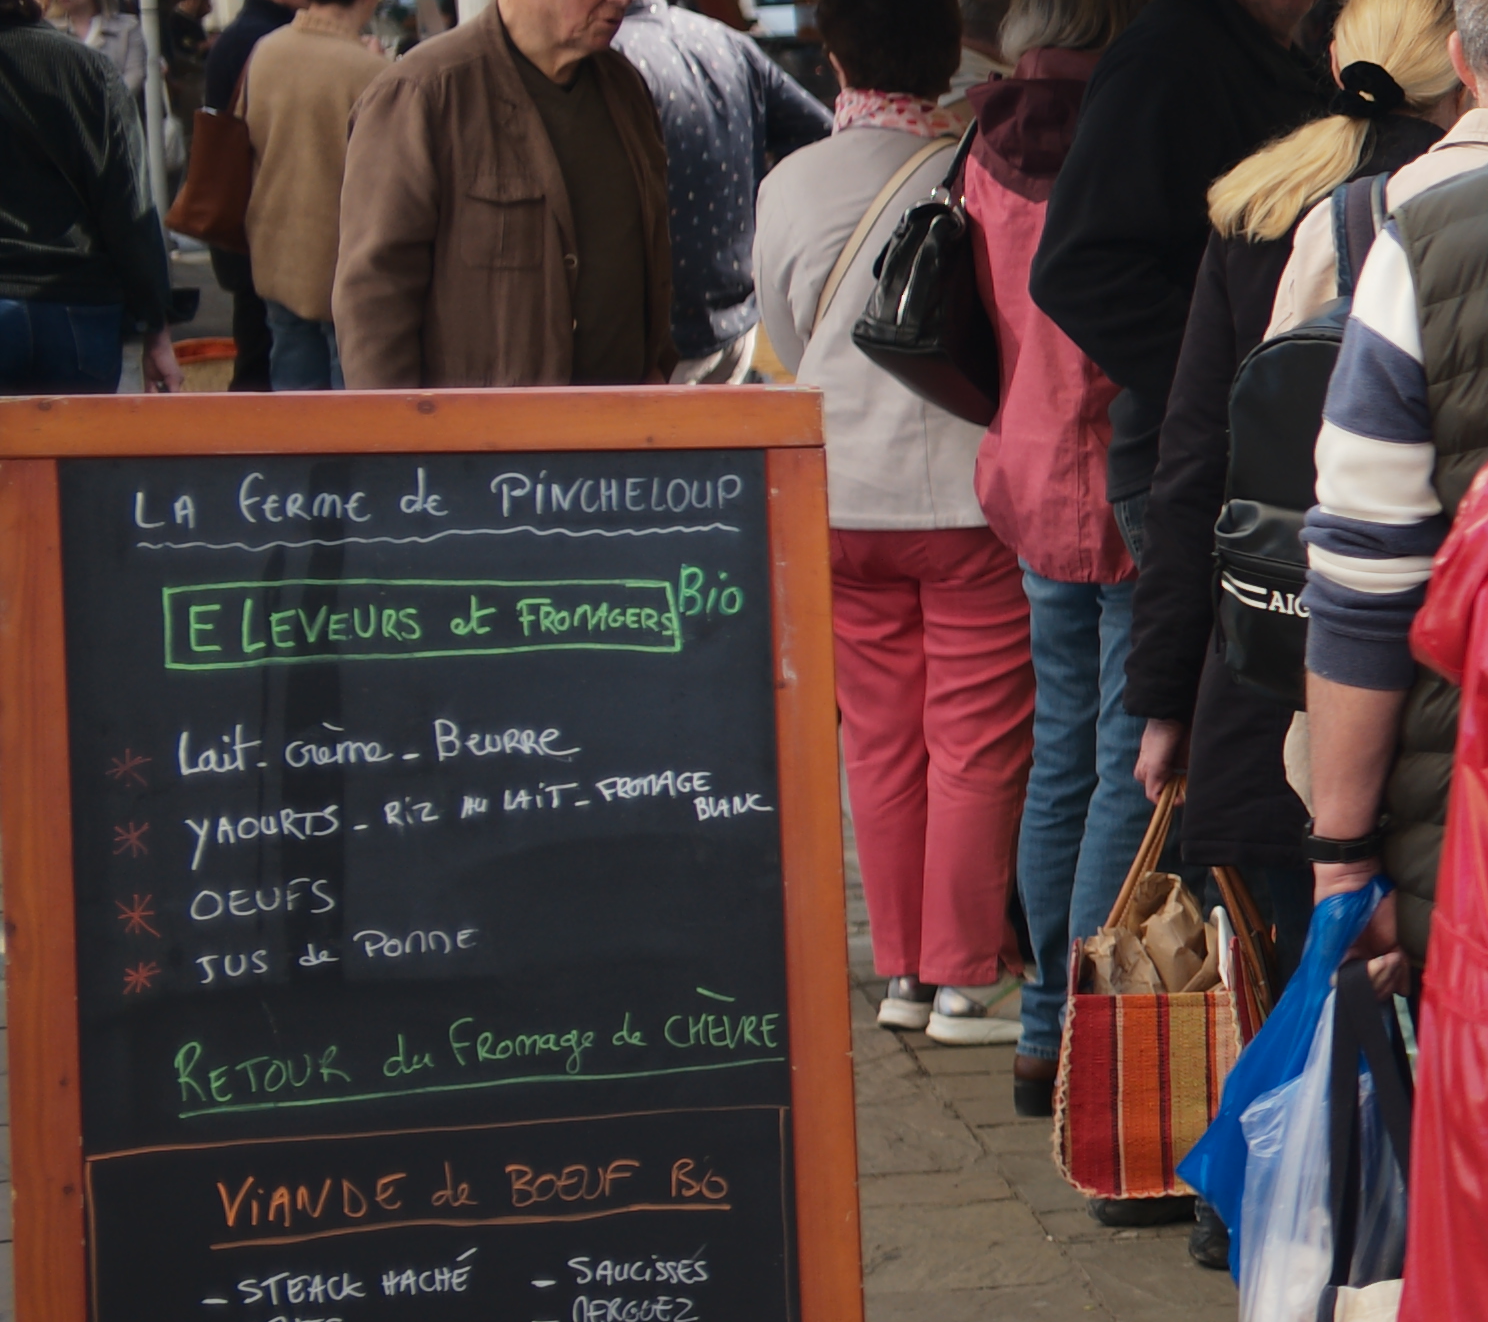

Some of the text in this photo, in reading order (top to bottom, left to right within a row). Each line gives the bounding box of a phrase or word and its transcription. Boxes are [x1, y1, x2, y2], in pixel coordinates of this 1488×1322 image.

[134, 490, 194, 528] LA
[400, 466, 448, 516] de
[450, 594, 497, 636] et
[516, 597, 678, 637] FROMAGERS
[680, 563, 743, 621] Bio
[184, 804, 340, 870] YAOURTS
[595, 770, 713, 803] FROMAGE
[694, 793, 774, 822] BLANC
[190, 877, 336, 920] OEUFS
[195, 949, 269, 984] JUS
[298, 942, 340, 966] de
[174, 1040, 352, 1103] RETOUR
[382, 1032, 436, 1078] du
[611, 1011, 648, 1047] de
[431, 1161, 478, 1207] de
[505, 1159, 641, 1208] BOEUF
